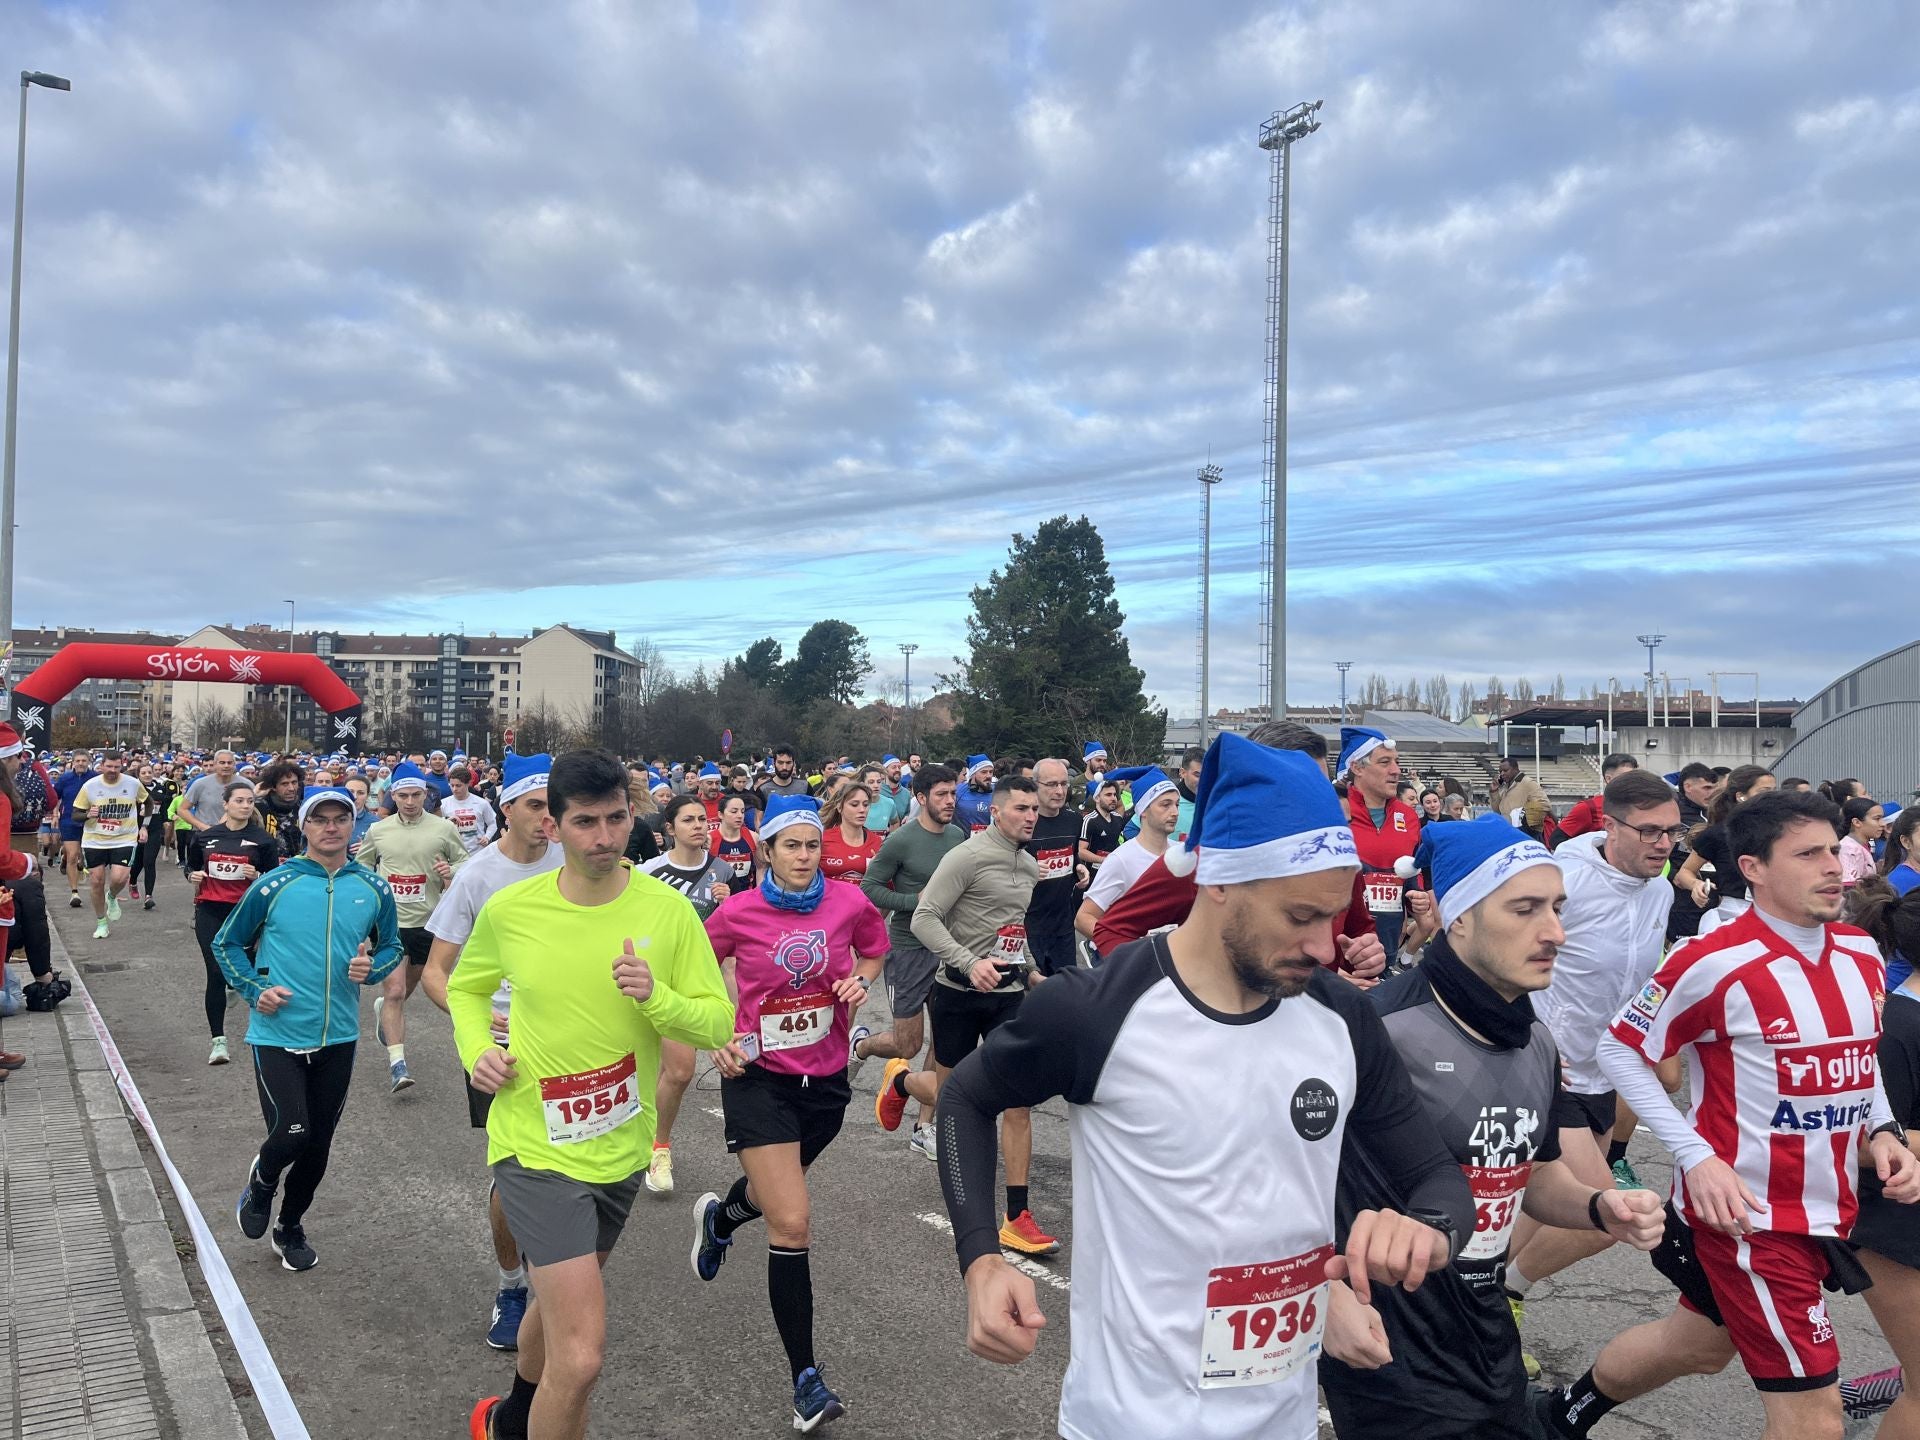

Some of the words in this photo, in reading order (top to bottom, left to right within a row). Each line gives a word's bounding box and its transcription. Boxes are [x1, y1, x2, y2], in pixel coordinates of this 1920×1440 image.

[147, 652, 219, 679] gijón
[102, 824, 115, 832] 912
[216, 863, 239, 873] 567
[1049, 857, 1070, 870] 664
[392, 884, 421, 895] 1392
[1370, 886, 1398, 901] 1159
[1637, 1000, 1653, 1011] LFP
[779, 1010, 818, 1033] 461
[1765, 1031, 1799, 1041] ASTORE
[572, 1072, 599, 1082] Carrera
[600, 1062, 624, 1075] Popular
[569, 1080, 616, 1097] Nochebuena
[557, 1082, 630, 1125] 1954
[1305, 1110, 1327, 1119] SPORT
[1468, 1106, 1507, 1156] 45
[1241, 1267, 1255, 1279] 37
[1260, 1263, 1295, 1276] Carrera
[1295, 1252, 1321, 1268] Popular
[1281, 1274, 1292, 1284] de
[1251, 1281, 1309, 1303] Nochebuena
[1227, 1291, 1317, 1351] 1936
[1263, 1347, 1292, 1360] ROBERTO
